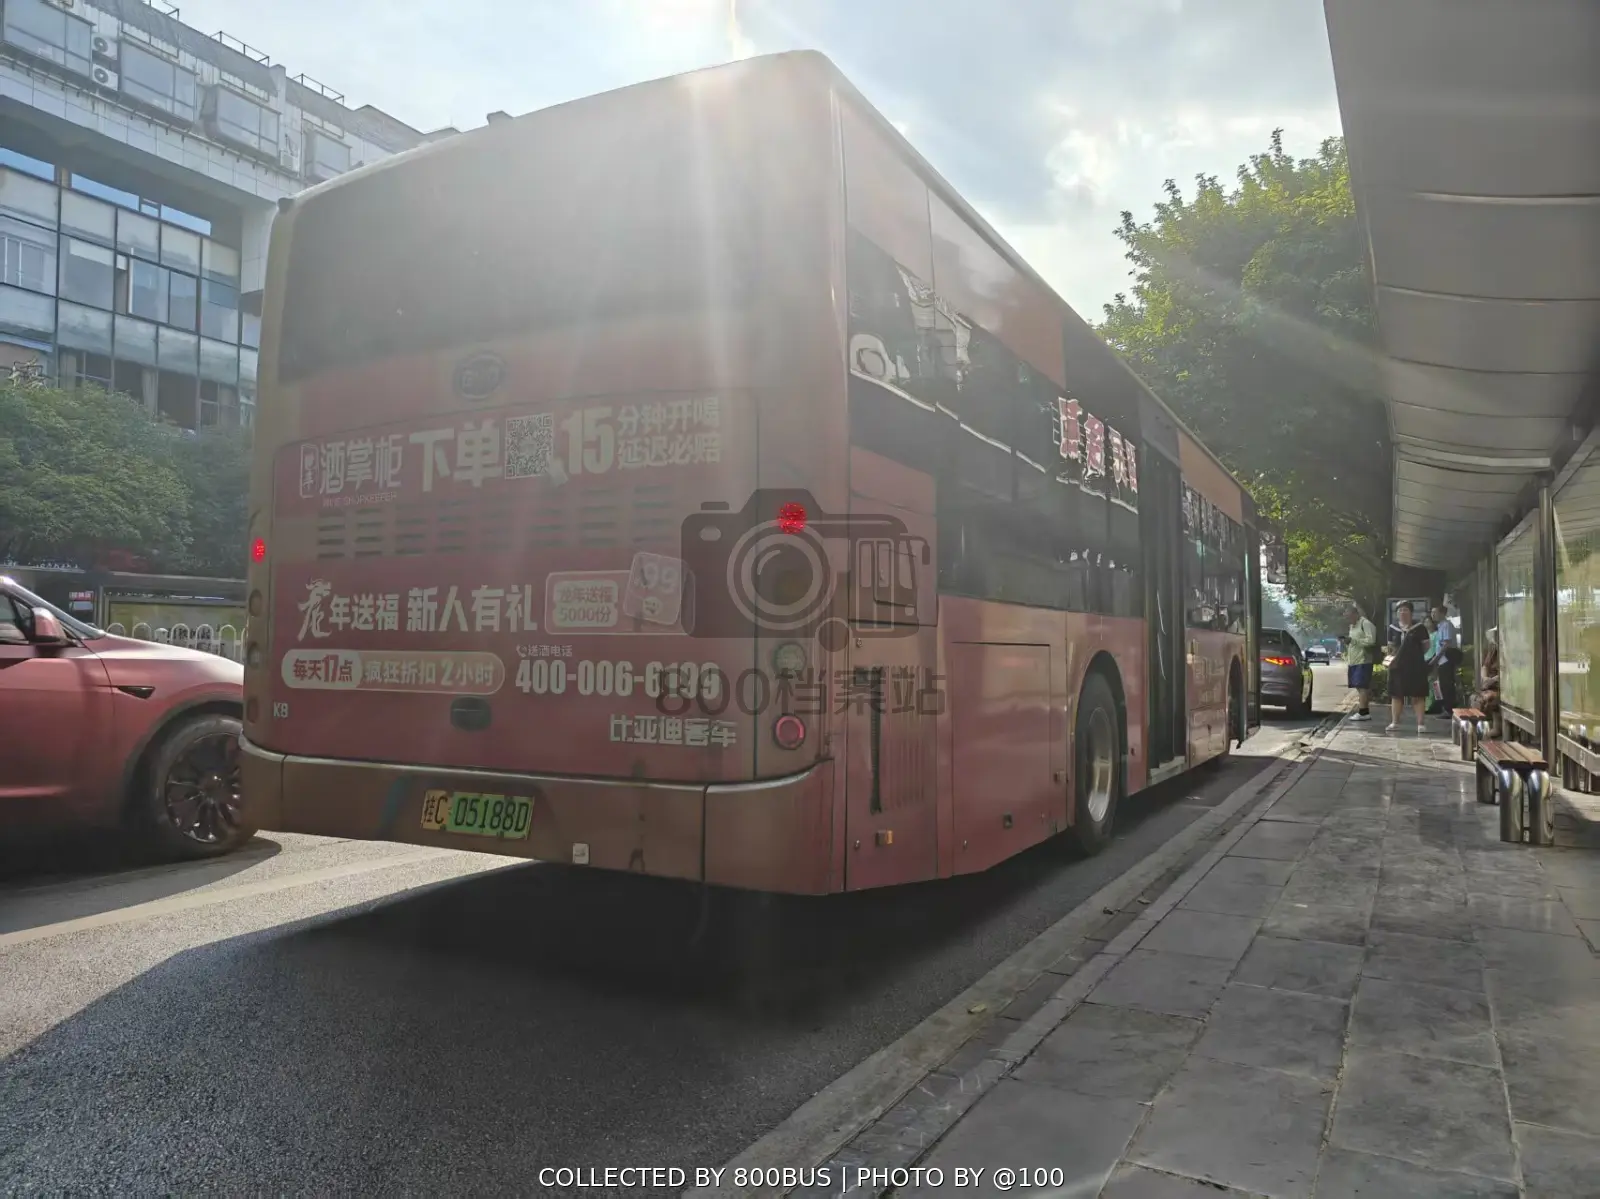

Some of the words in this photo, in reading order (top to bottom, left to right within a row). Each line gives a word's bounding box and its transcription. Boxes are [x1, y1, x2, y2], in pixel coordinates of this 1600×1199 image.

[319, 434, 404, 494] 酒掌柜
[409, 418, 502, 493] 下单
[561, 406, 615, 474] 15
[617, 431, 721, 471] 延迟必赔
[297, 575, 400, 642] 龙年送福
[406, 584, 538, 633] 新人有礼
[559, 606, 612, 623] 5000份
[528, 644, 573, 657] 送酒电话
[515, 660, 720, 700] 400-006-6199
[609, 713, 738, 748] 比亚迪客车
[454, 798, 530, 832] 05188D
